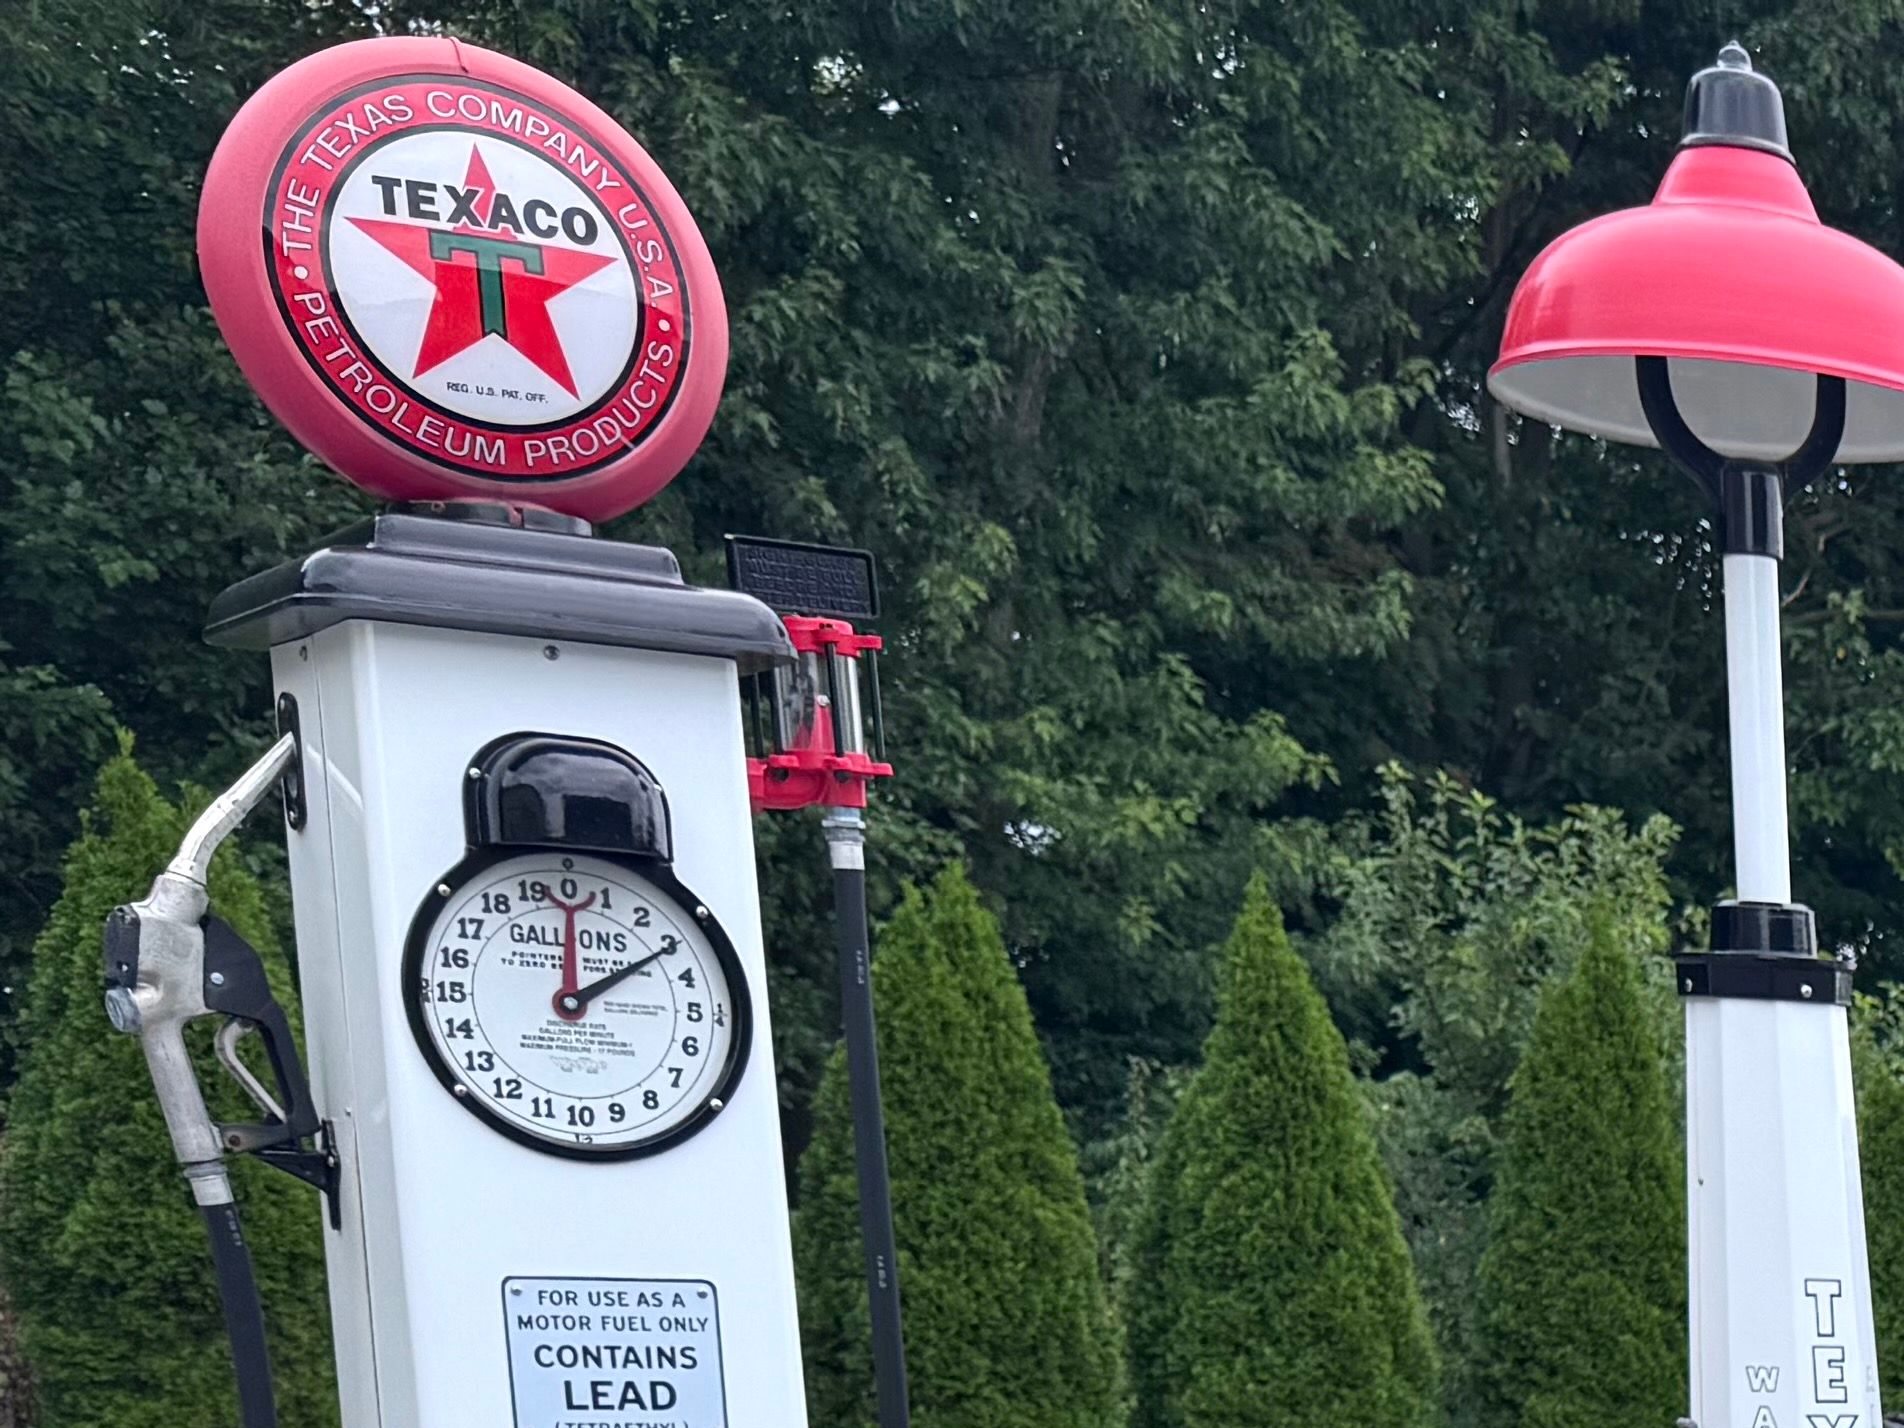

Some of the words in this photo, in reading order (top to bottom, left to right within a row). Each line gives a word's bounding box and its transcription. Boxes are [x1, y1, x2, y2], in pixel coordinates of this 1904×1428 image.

[301, 95, 414, 172] TEXAS
[427, 90, 621, 191] COMPANY
[283, 178, 321, 257] THE
[371, 175, 598, 246] TEXACO
[294, 292, 508, 464] PETROLEUM
[524, 339, 674, 467] PRODUCTS
[560, 878, 577, 899] 0
[601, 887, 612, 909] 1
[481, 892, 511, 914] 18
[633, 907, 651, 927] 2
[457, 917, 485, 940] 17
[510, 923, 627, 952] GALLONS
[440, 946, 469, 969] 16
[678, 967, 696, 989] 4
[436, 981, 467, 1003] 15
[687, 1002, 703, 1023] 5
[445, 1018, 474, 1040] 14
[682, 1036, 699, 1057] 6
[465, 1050, 495, 1072] 13
[493, 1077, 523, 1100] 12
[668, 1067, 684, 1088] 7
[531, 1096, 556, 1119] 11
[643, 1090, 659, 1110] 8
[566, 1105, 595, 1127] 10
[608, 1103, 626, 1123] 9
[538, 1290, 578, 1306] FOR
[588, 1291, 630, 1307] USE
[637, 1292, 663, 1308] AS
[672, 1292, 686, 1308] A
[517, 1315, 591, 1331] MOTOR
[601, 1316, 652, 1332] FUEL
[659, 1317, 709, 1332] ONLY
[534, 1344, 698, 1370] CONTAINS
[564, 1380, 677, 1411] LEAD
